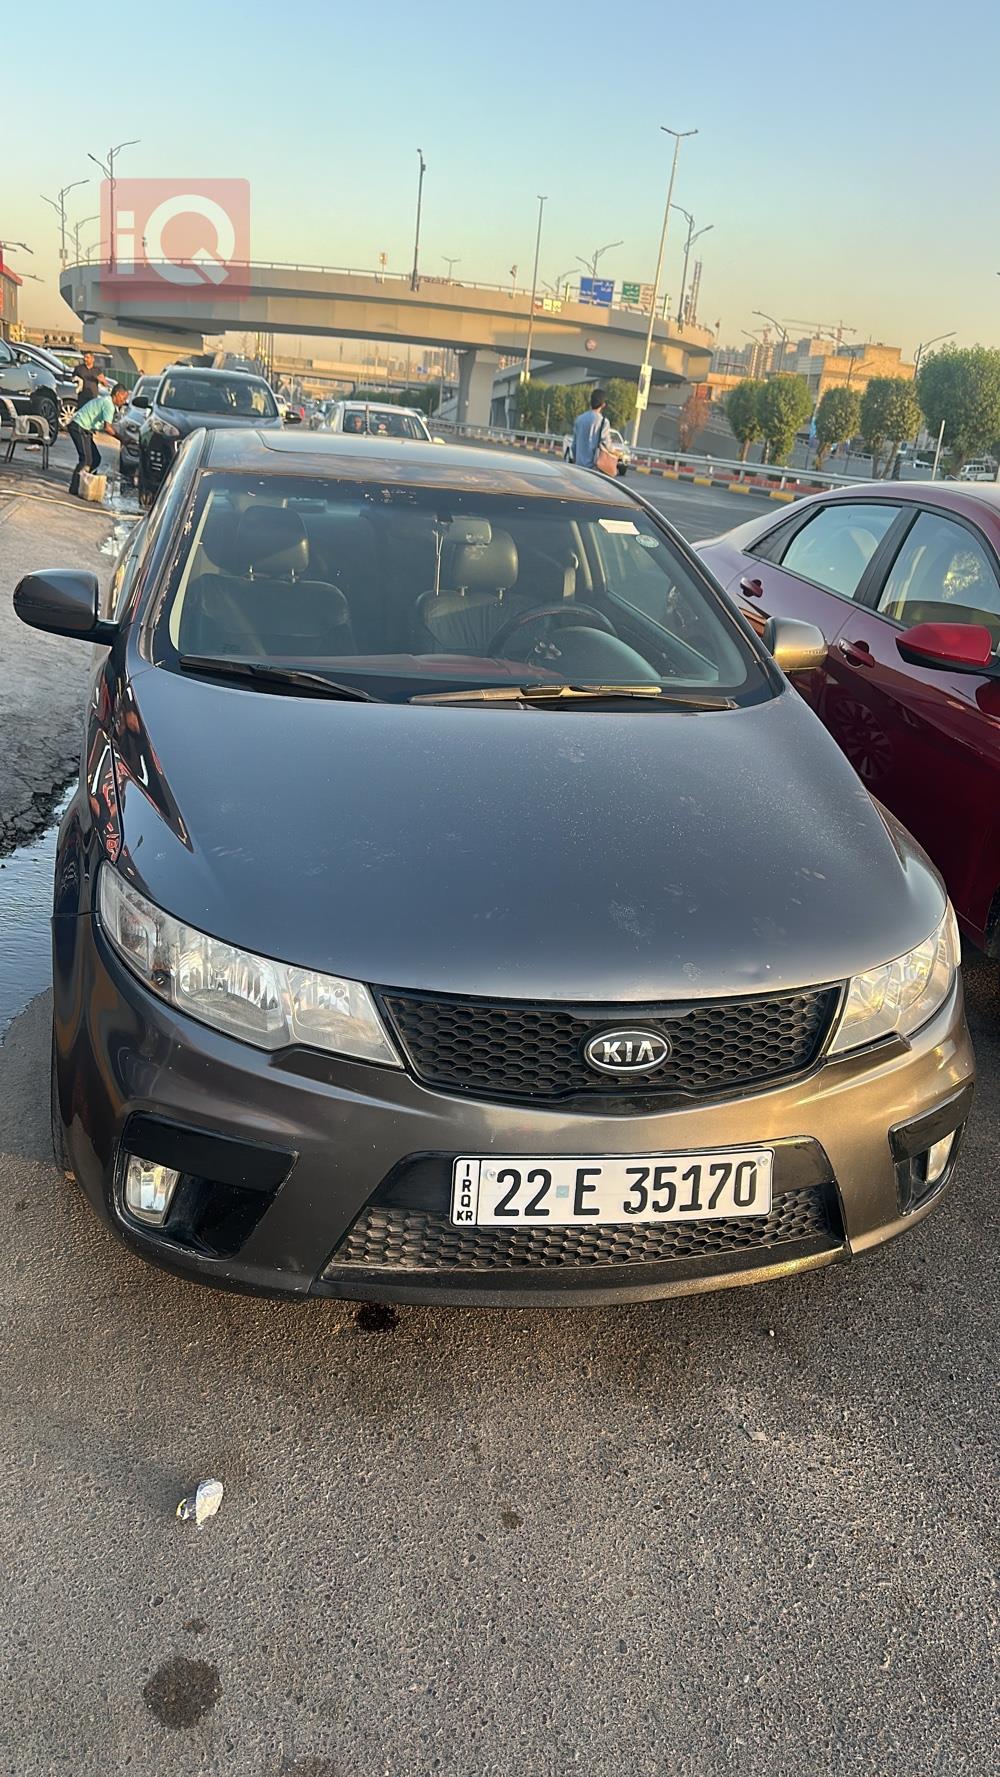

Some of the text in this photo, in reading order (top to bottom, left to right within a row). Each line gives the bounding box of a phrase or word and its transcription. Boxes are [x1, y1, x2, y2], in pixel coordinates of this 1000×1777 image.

[602, 1040, 655, 1063] KIA
[494, 1160, 757, 1217] 22 E 35170
[456, 1210, 473, 1222] KR
